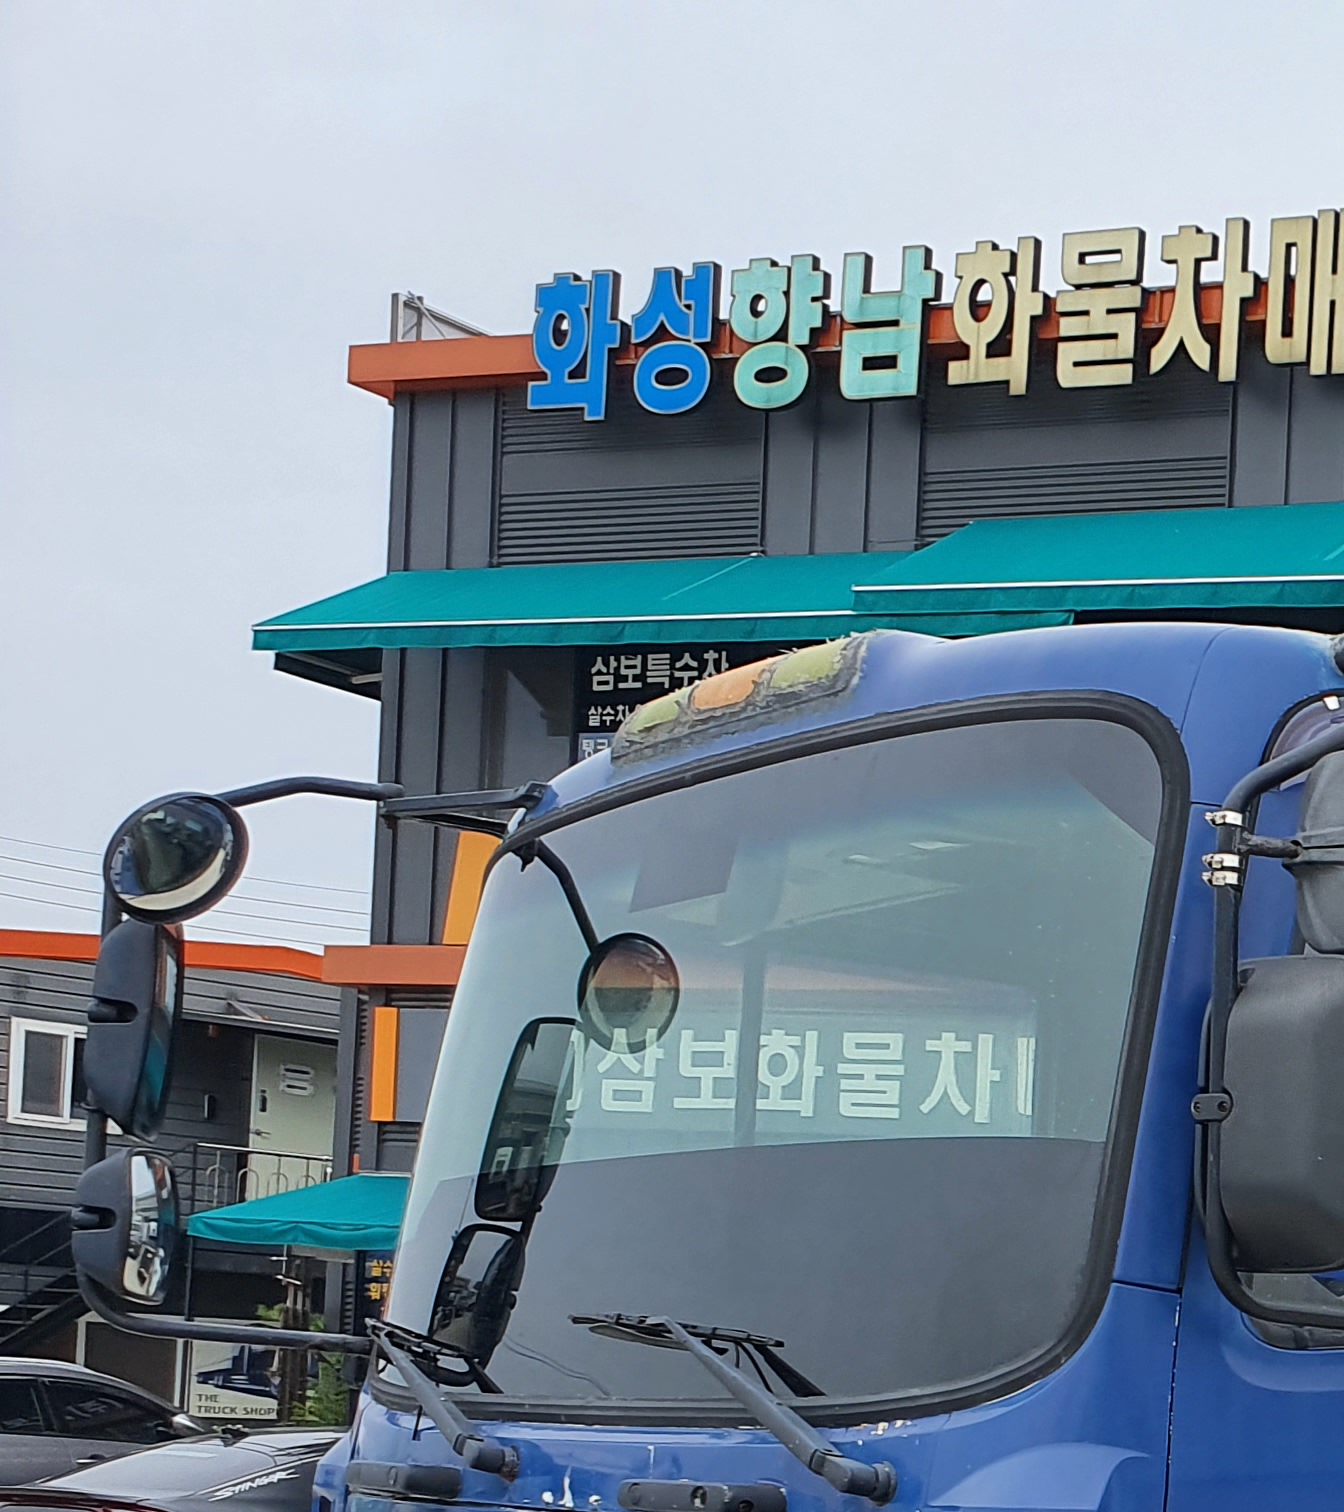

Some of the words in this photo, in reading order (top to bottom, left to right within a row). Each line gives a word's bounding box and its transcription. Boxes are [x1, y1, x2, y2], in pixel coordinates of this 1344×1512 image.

[590, 650, 729, 691] 삼보특수차
[197, 1393, 219, 1403] THE
[197, 1404, 238, 1415] TRUCK
[243, 1406, 275, 1416] SHOP
